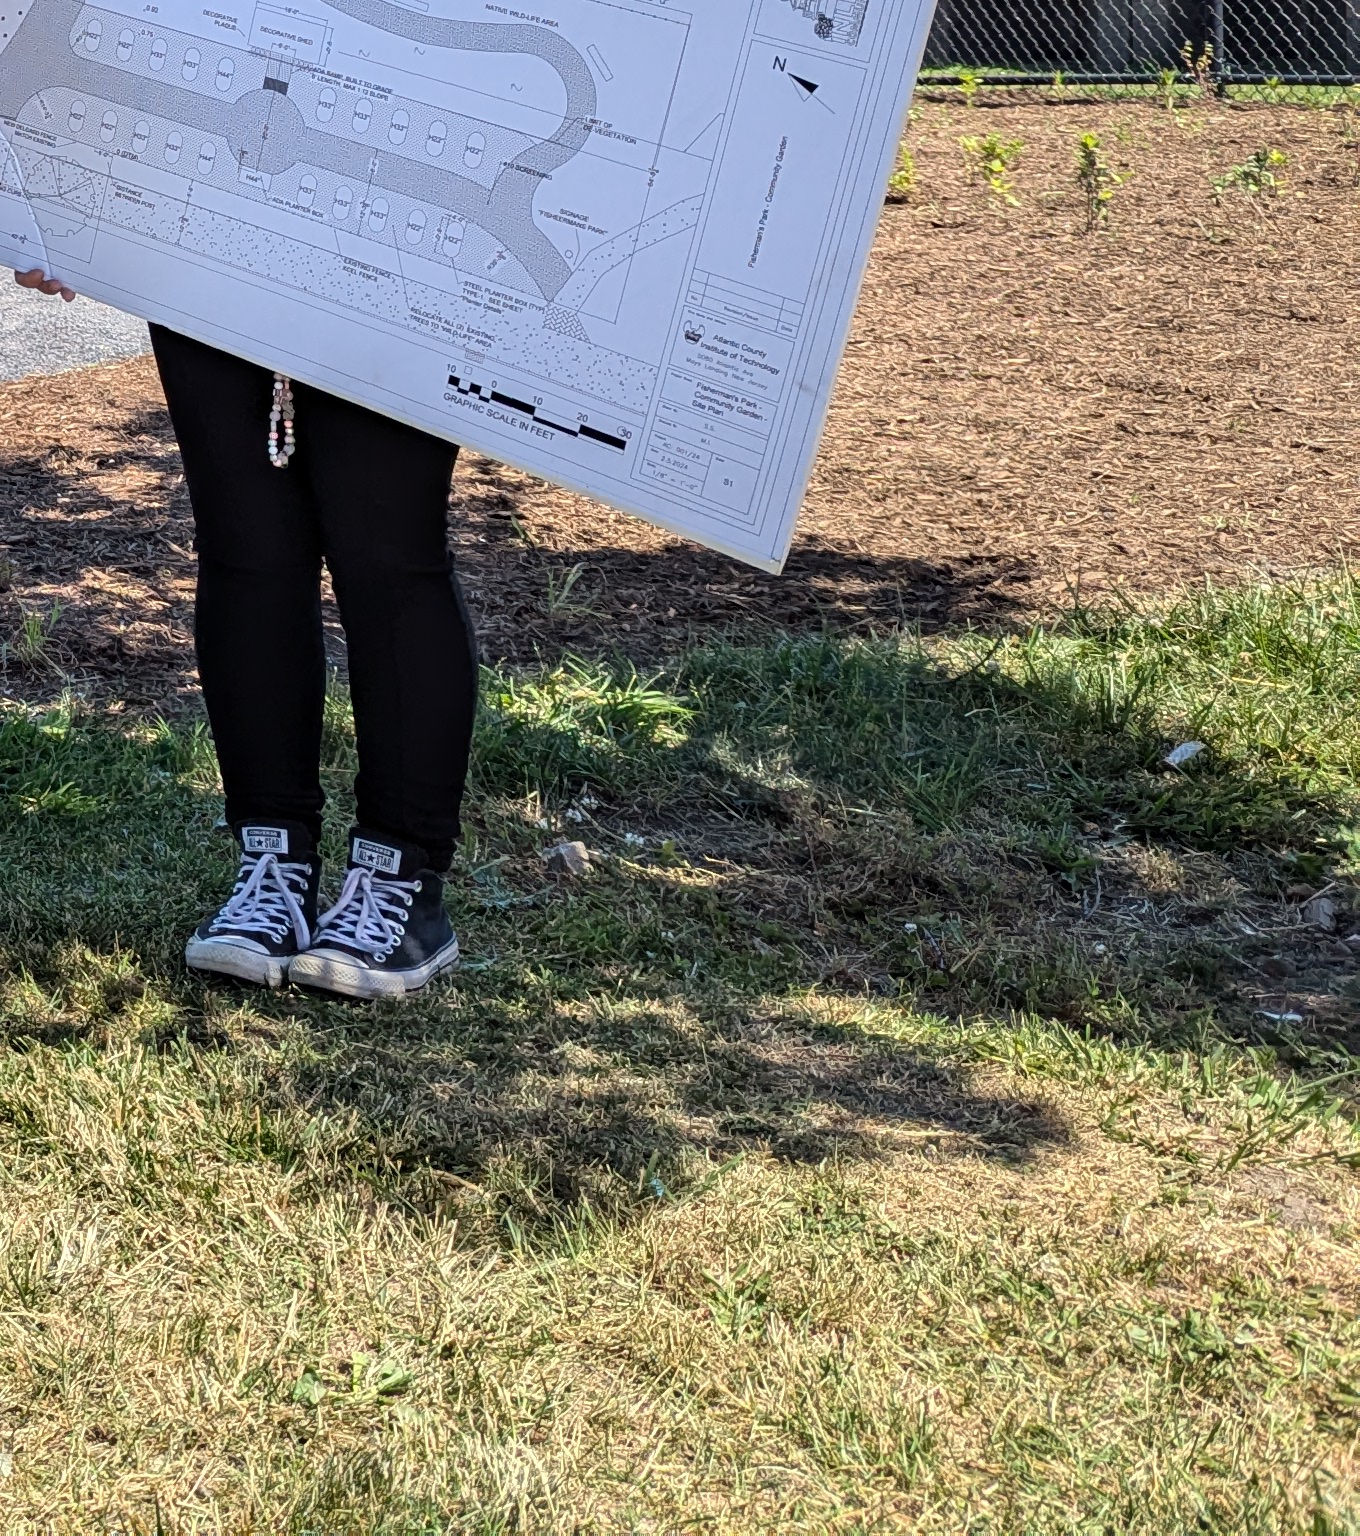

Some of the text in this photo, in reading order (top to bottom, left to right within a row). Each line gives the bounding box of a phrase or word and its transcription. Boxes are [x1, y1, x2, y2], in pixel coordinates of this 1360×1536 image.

[201, 8, 239, 25] DECORATIVE
[484, 2, 508, 15] NATIVE
[540, 17, 560, 29] AREA
[259, 25, 314, 46] DECORATIVE SHED
[771, 55, 788, 72] N
[284, 200, 311, 215] PLANTER
[746, 134, 789, 269] Fisherman's Park Community Garden
[558, 207, 590, 223] SIGNAGE
[343, 257, 392, 280] EXISTING FENCE
[357, 270, 378, 283] FENCE
[463, 279, 483, 292] STEEL
[483, 286, 513, 303] PLANTER
[409, 305, 442, 323] RELOCATE
[500, 300, 523, 314] SHEET
[408, 313, 430, 327] TREES
[473, 336, 493, 349] AREA
[711, 333, 741, 350] Atlantic
[740, 343, 768, 359] County
[698, 341, 729, 359] Institute
[737, 354, 781, 376] Technology
[445, 362, 457, 374] 10
[489, 379, 498, 389] 0
[695, 381, 740, 403] Fisherman's
[746, 377, 769, 391] Jersey
[531, 394, 544, 406] 10
[692, 390, 735, 412] Community
[734, 405, 764, 423] Garden
[442, 391, 555, 442] GRAPHIC SCALE IN FEET
[575, 411, 589, 424] 20
[619, 427, 633, 440] 30
[248, 837, 281, 849] ALL STAR
[358, 850, 392, 869] ALL STAR
